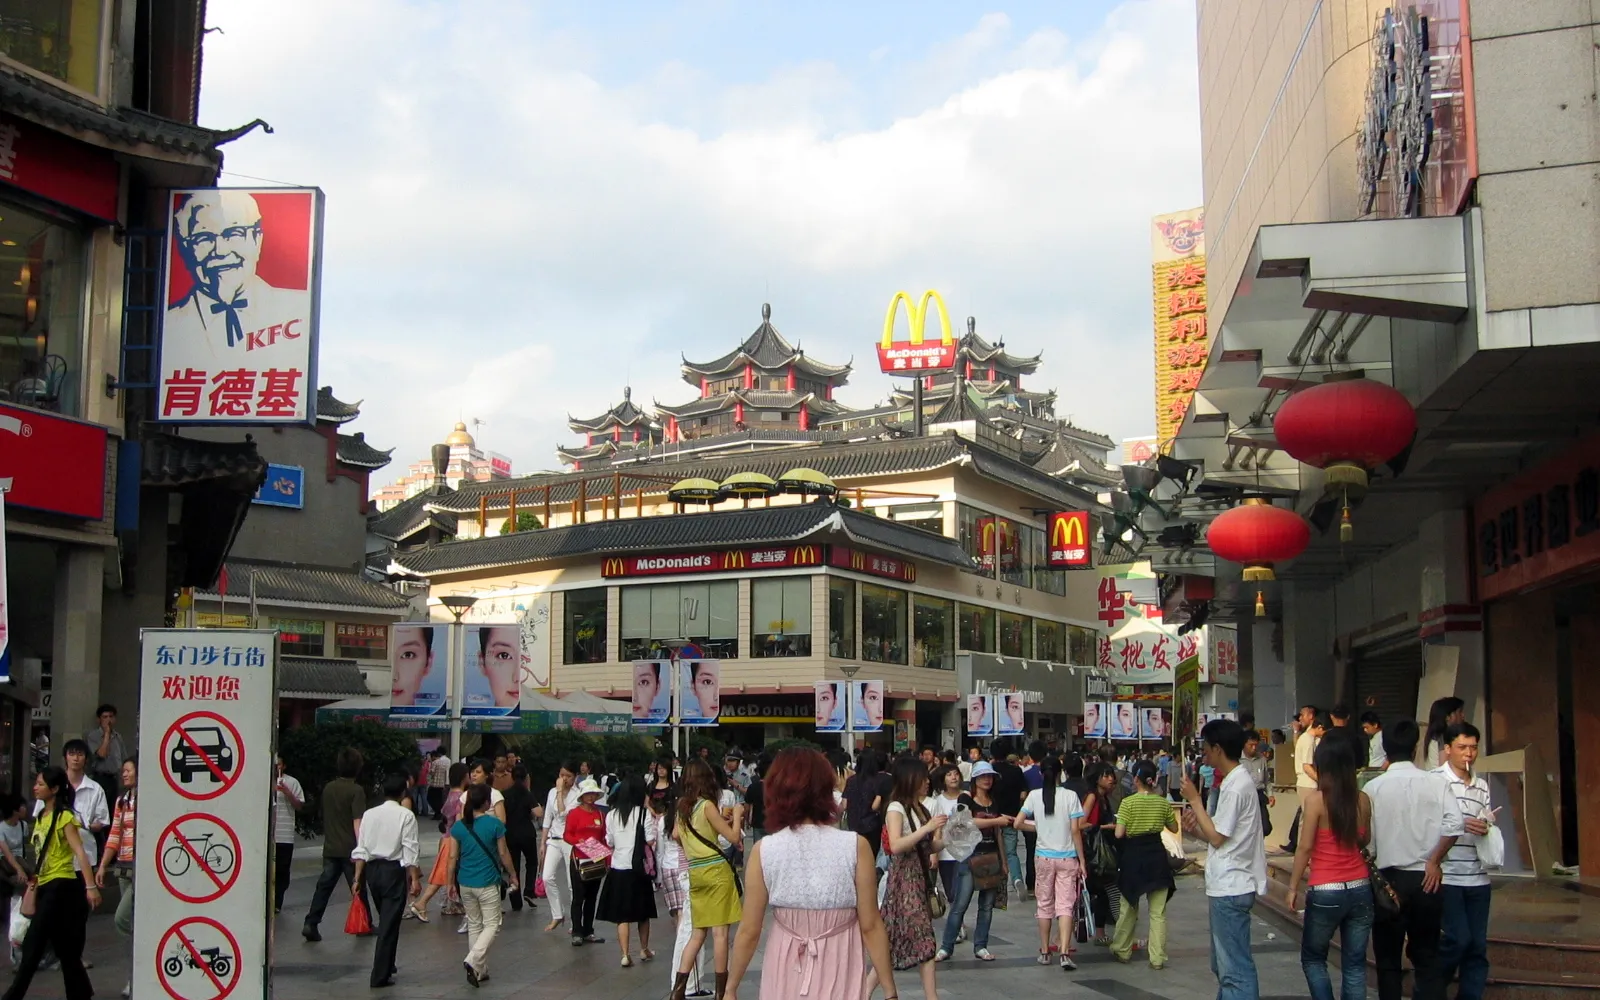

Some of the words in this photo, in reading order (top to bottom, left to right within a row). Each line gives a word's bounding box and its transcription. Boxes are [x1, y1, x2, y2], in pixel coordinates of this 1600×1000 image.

[246, 319, 302, 352] KFC
[886, 347, 948, 359] McDonald's
[1167, 263, 1207, 437] 法拉利游戏
[893, 356, 941, 369] 麦当劳
[163, 368, 303, 417] 肯德基
[636, 555, 712, 571] McDonald's
[751, 550, 787, 563] 麦当劳
[1052, 549, 1085, 561] 麦当劳
[872, 558, 897, 575] 麦当劳
[337, 624, 385, 638] 西部牛扒城
[155, 645, 266, 667] 东门步行街
[161, 675, 240, 701] 欢迎您
[720, 703, 812, 717] McDonald'
